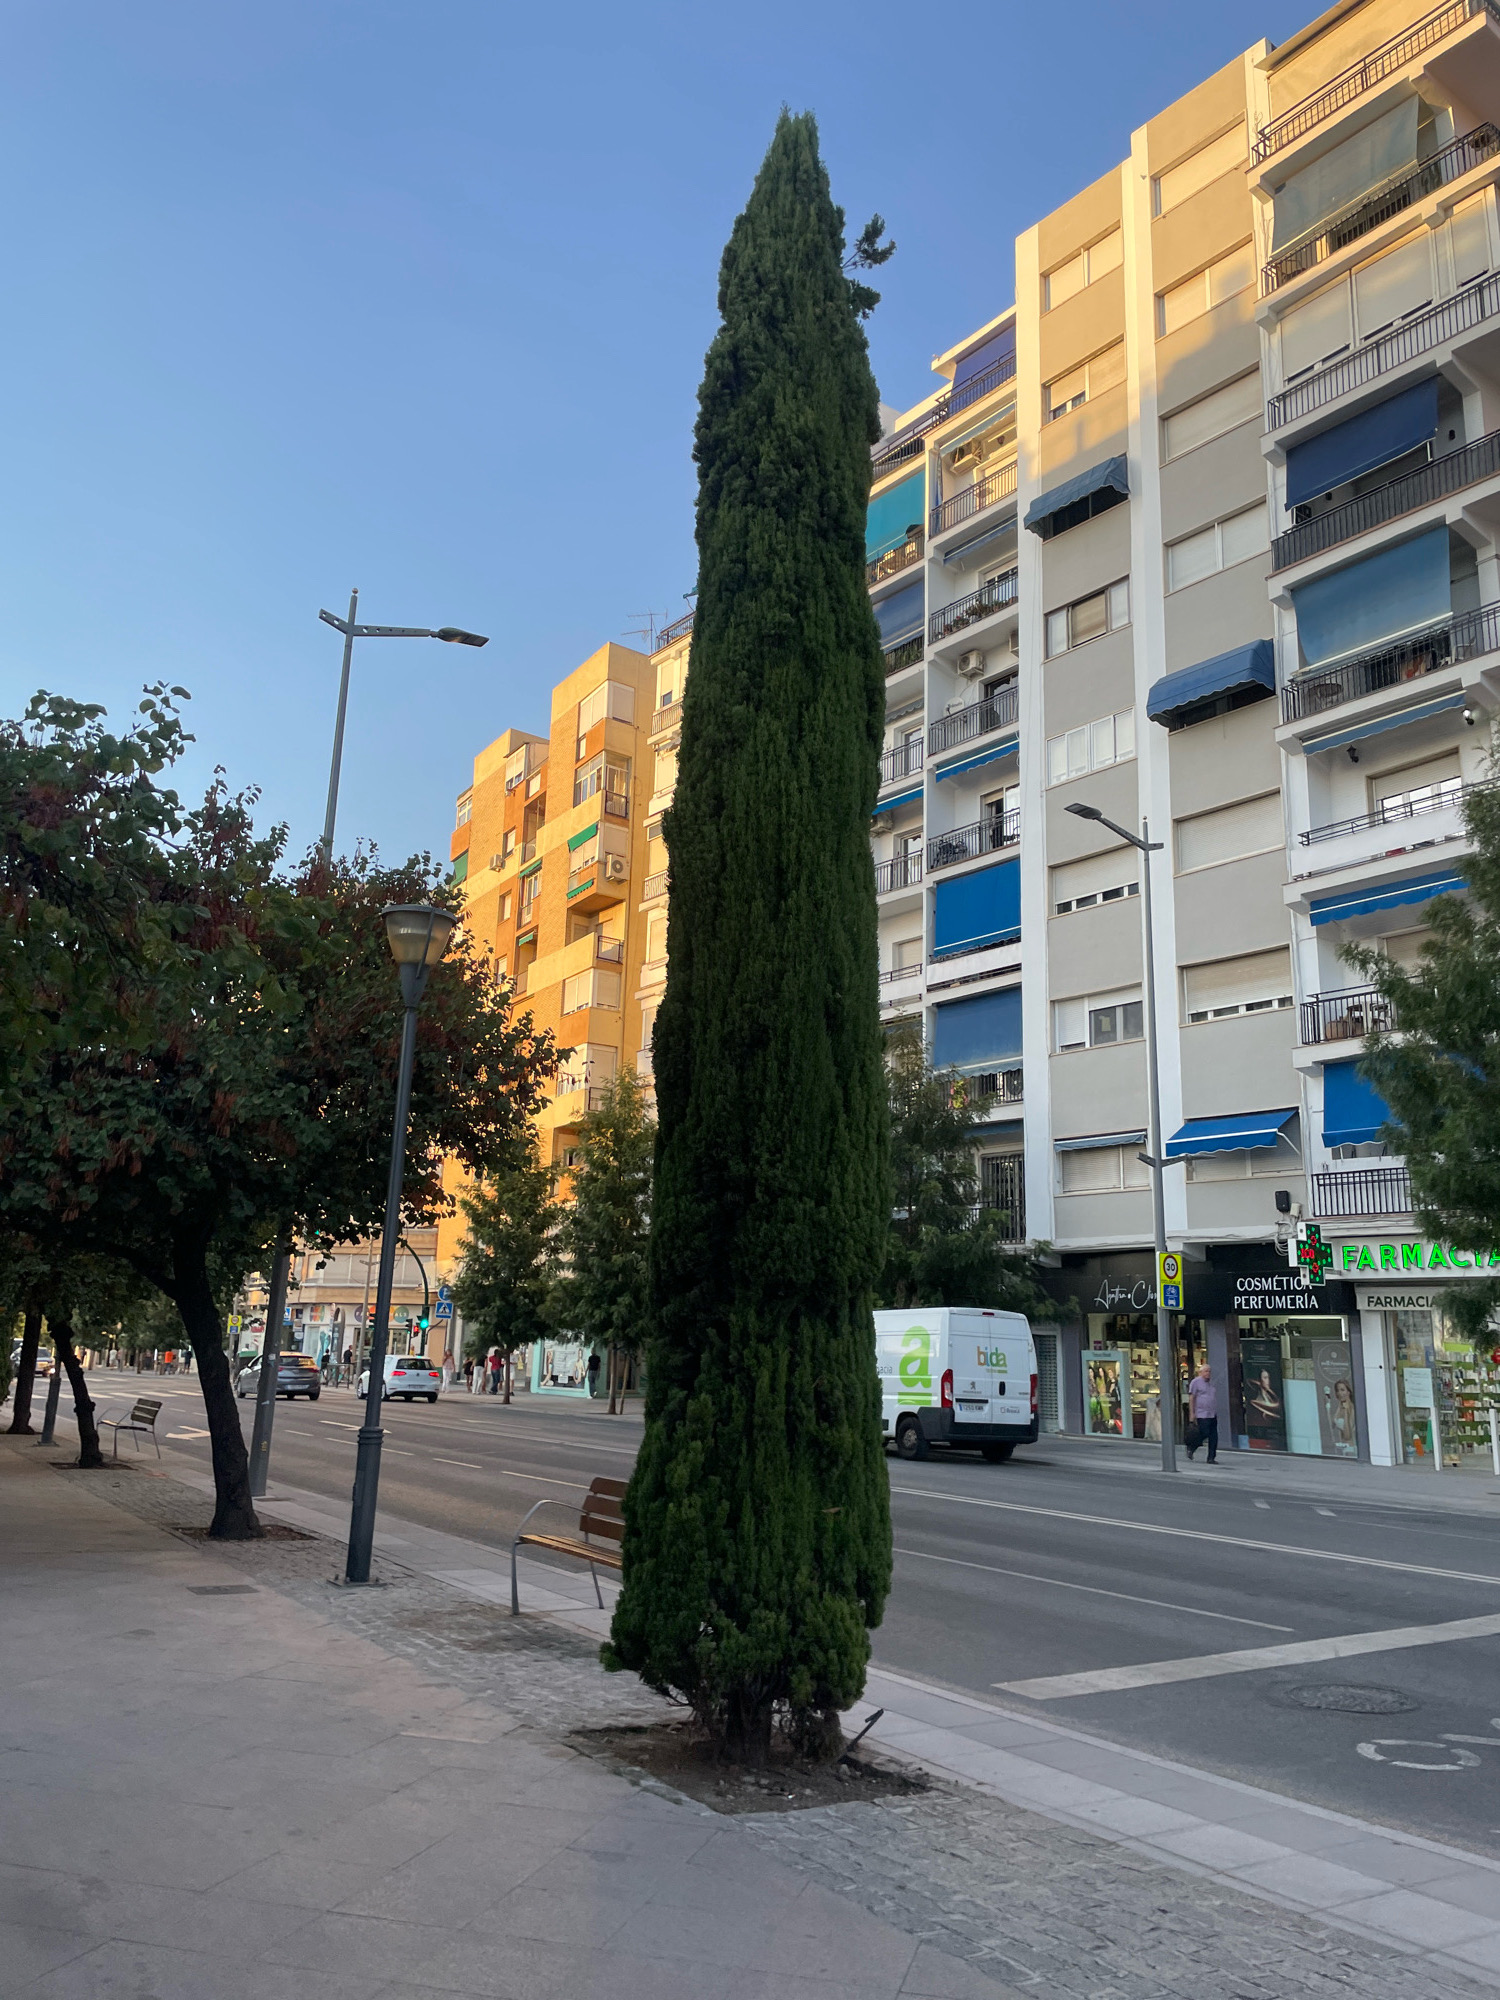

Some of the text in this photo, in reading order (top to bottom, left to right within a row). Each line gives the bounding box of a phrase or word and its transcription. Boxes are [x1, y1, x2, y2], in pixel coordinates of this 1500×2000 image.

[1166, 1263, 1175, 1271] 30
[1236, 1275, 1312, 1291] COSMÉTIC
[1234, 1293, 1318, 1309] PERFUMERÍA
[977, 1345, 1008, 1367] bida
